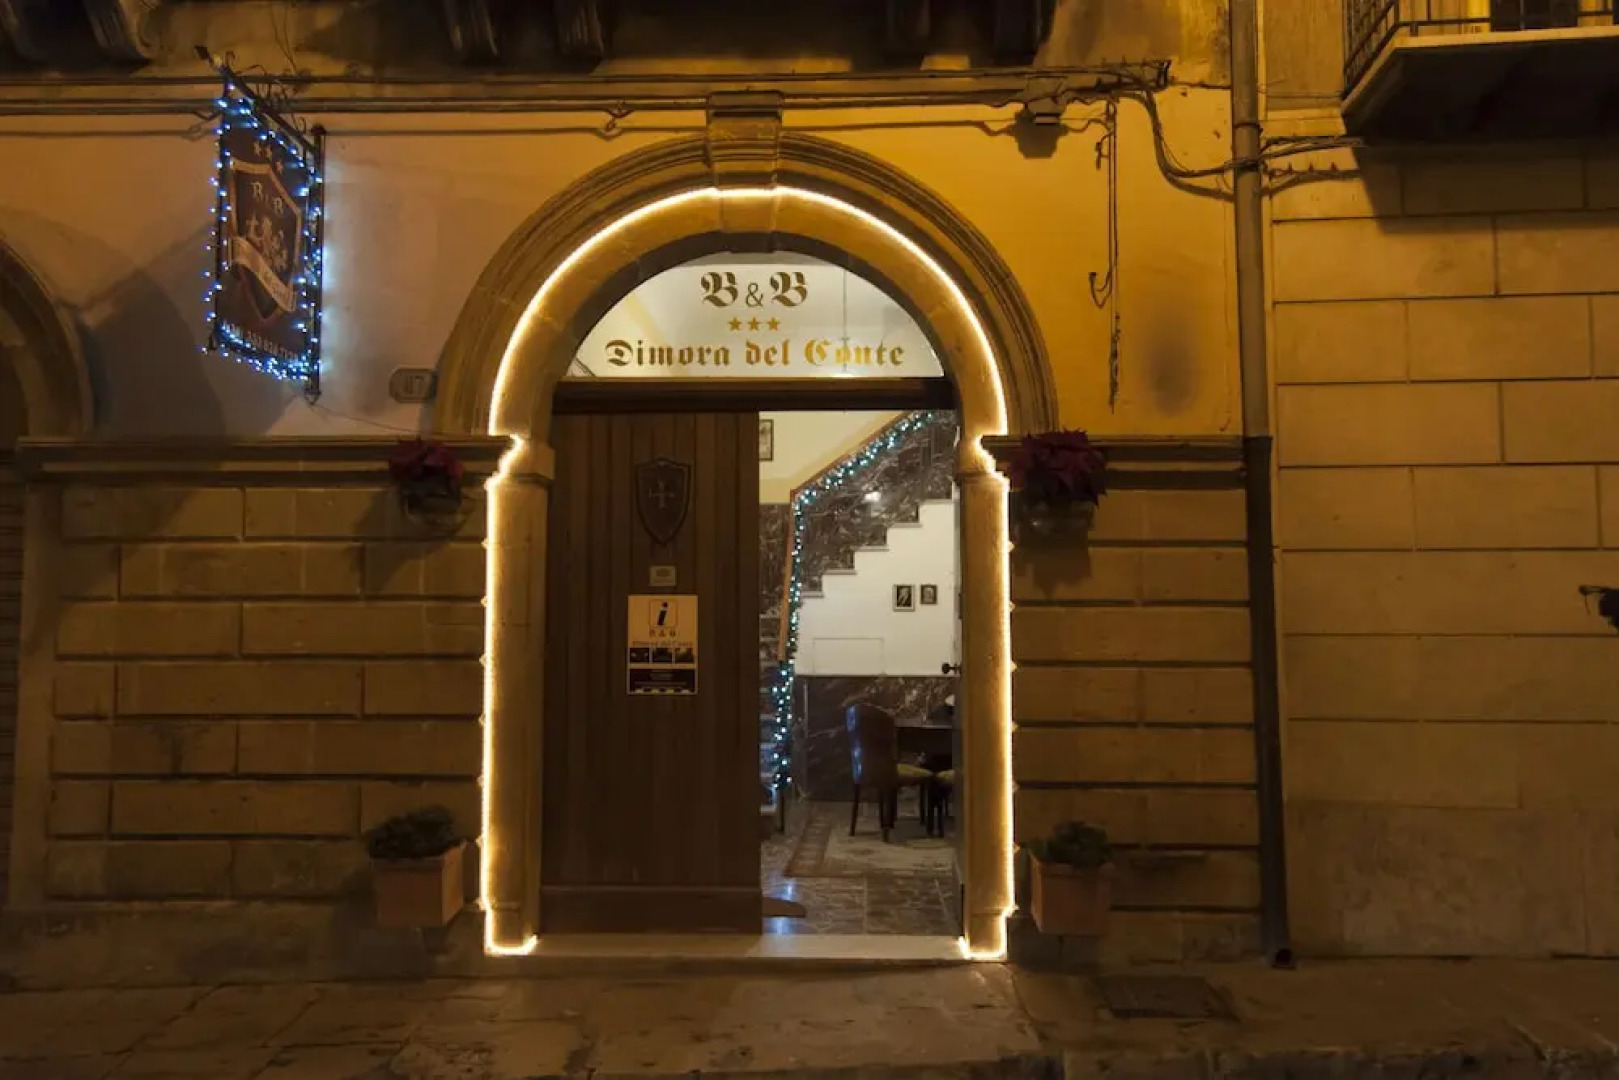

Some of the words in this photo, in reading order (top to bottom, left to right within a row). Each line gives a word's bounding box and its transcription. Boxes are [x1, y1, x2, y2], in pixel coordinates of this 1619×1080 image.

[701, 271, 739, 308] B
[745, 282, 764, 308] &
[769, 271, 808, 308] B
[605, 339, 730, 366] Dimora
[745, 338, 790, 366] del
[804, 338, 905, 366] Conte
